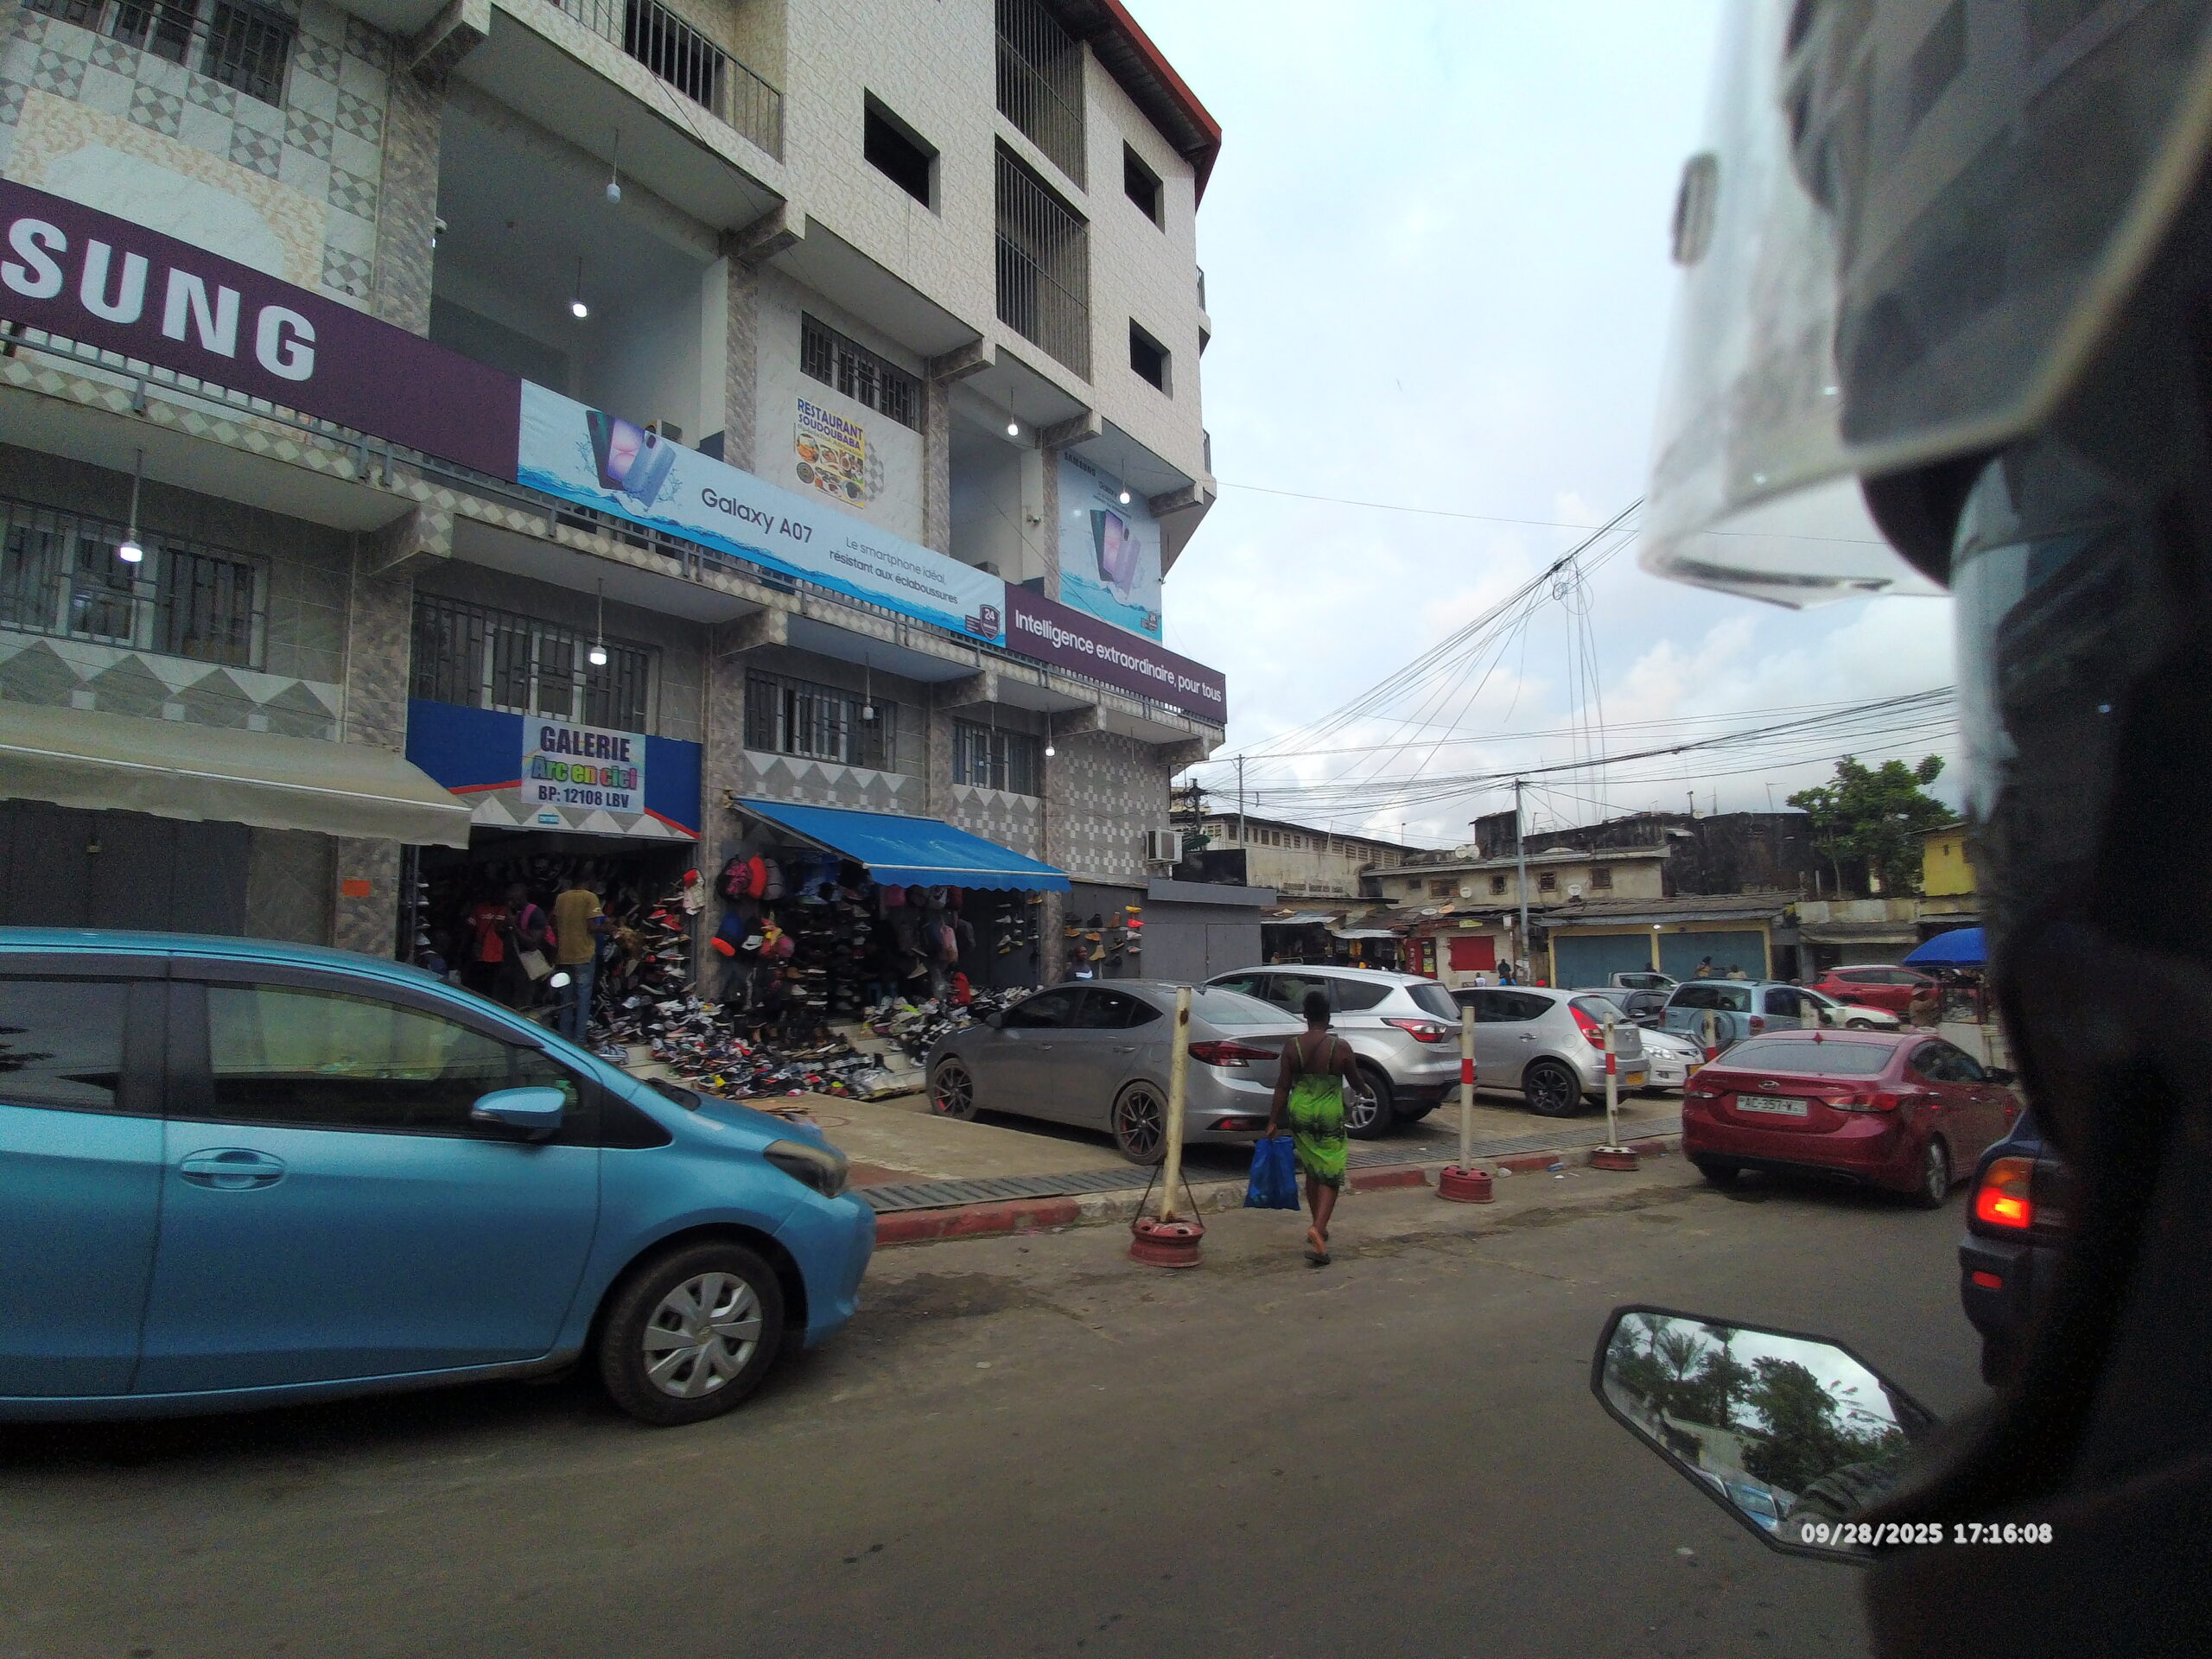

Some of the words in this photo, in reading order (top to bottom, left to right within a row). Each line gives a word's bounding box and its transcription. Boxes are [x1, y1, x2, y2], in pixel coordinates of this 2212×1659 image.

[0, 218, 316, 382] SUNG
[798, 398, 863, 441] RESTAURANT
[798, 414, 861, 450] SOUDOUBABA
[702, 487, 774, 534] Galaxy
[780, 518, 812, 543] A07
[846, 537, 858, 550] Le
[861, 544, 921, 575] smartphone
[830, 550, 874, 574] résistant
[876, 568, 893, 582] aux
[895, 574, 958, 604] éclaboussures
[984, 608, 995, 621] 24
[1015, 609, 1094, 653] Intelligence
[1096, 644, 1177, 688] extraordinaire,
[1178, 674, 1201, 694] pour
[1202, 684, 1221, 702] tous
[540, 726, 630, 762] GALERIE
[531, 755, 569, 782] Arc
[571, 764, 598, 785] en
[600, 766, 638, 790] ciel
[538, 785, 560, 802] BP:
[563, 788, 602, 806] 12108
[607, 792, 630, 808] LBV
